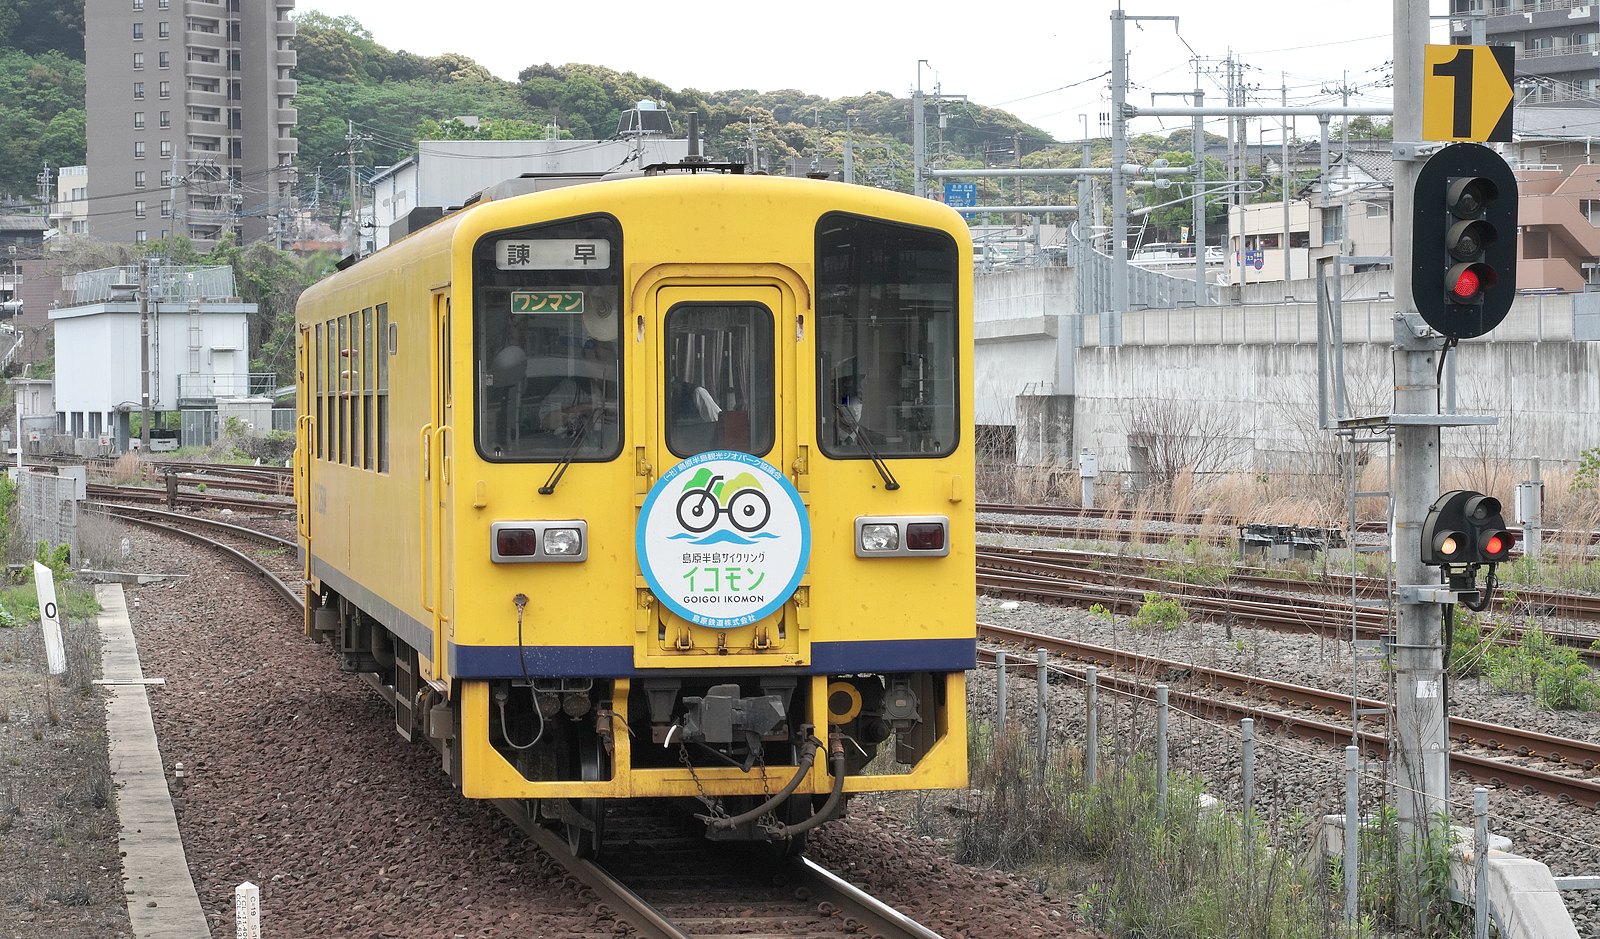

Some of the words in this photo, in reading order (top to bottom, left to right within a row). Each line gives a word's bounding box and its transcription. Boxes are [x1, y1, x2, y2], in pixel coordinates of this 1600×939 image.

[1433, 49, 1474, 138] 1
[507, 244, 597, 266] 諫早
[514, 294, 581, 311] ワンマン
[682, 552, 765, 564] 島原半島サイクリング
[683, 566, 765, 592] イコモン
[683, 595, 720, 603] GOIGOI
[724, 595, 764, 603] IKOMON
[692, 614, 756, 627] 島原鉄道株式会社
